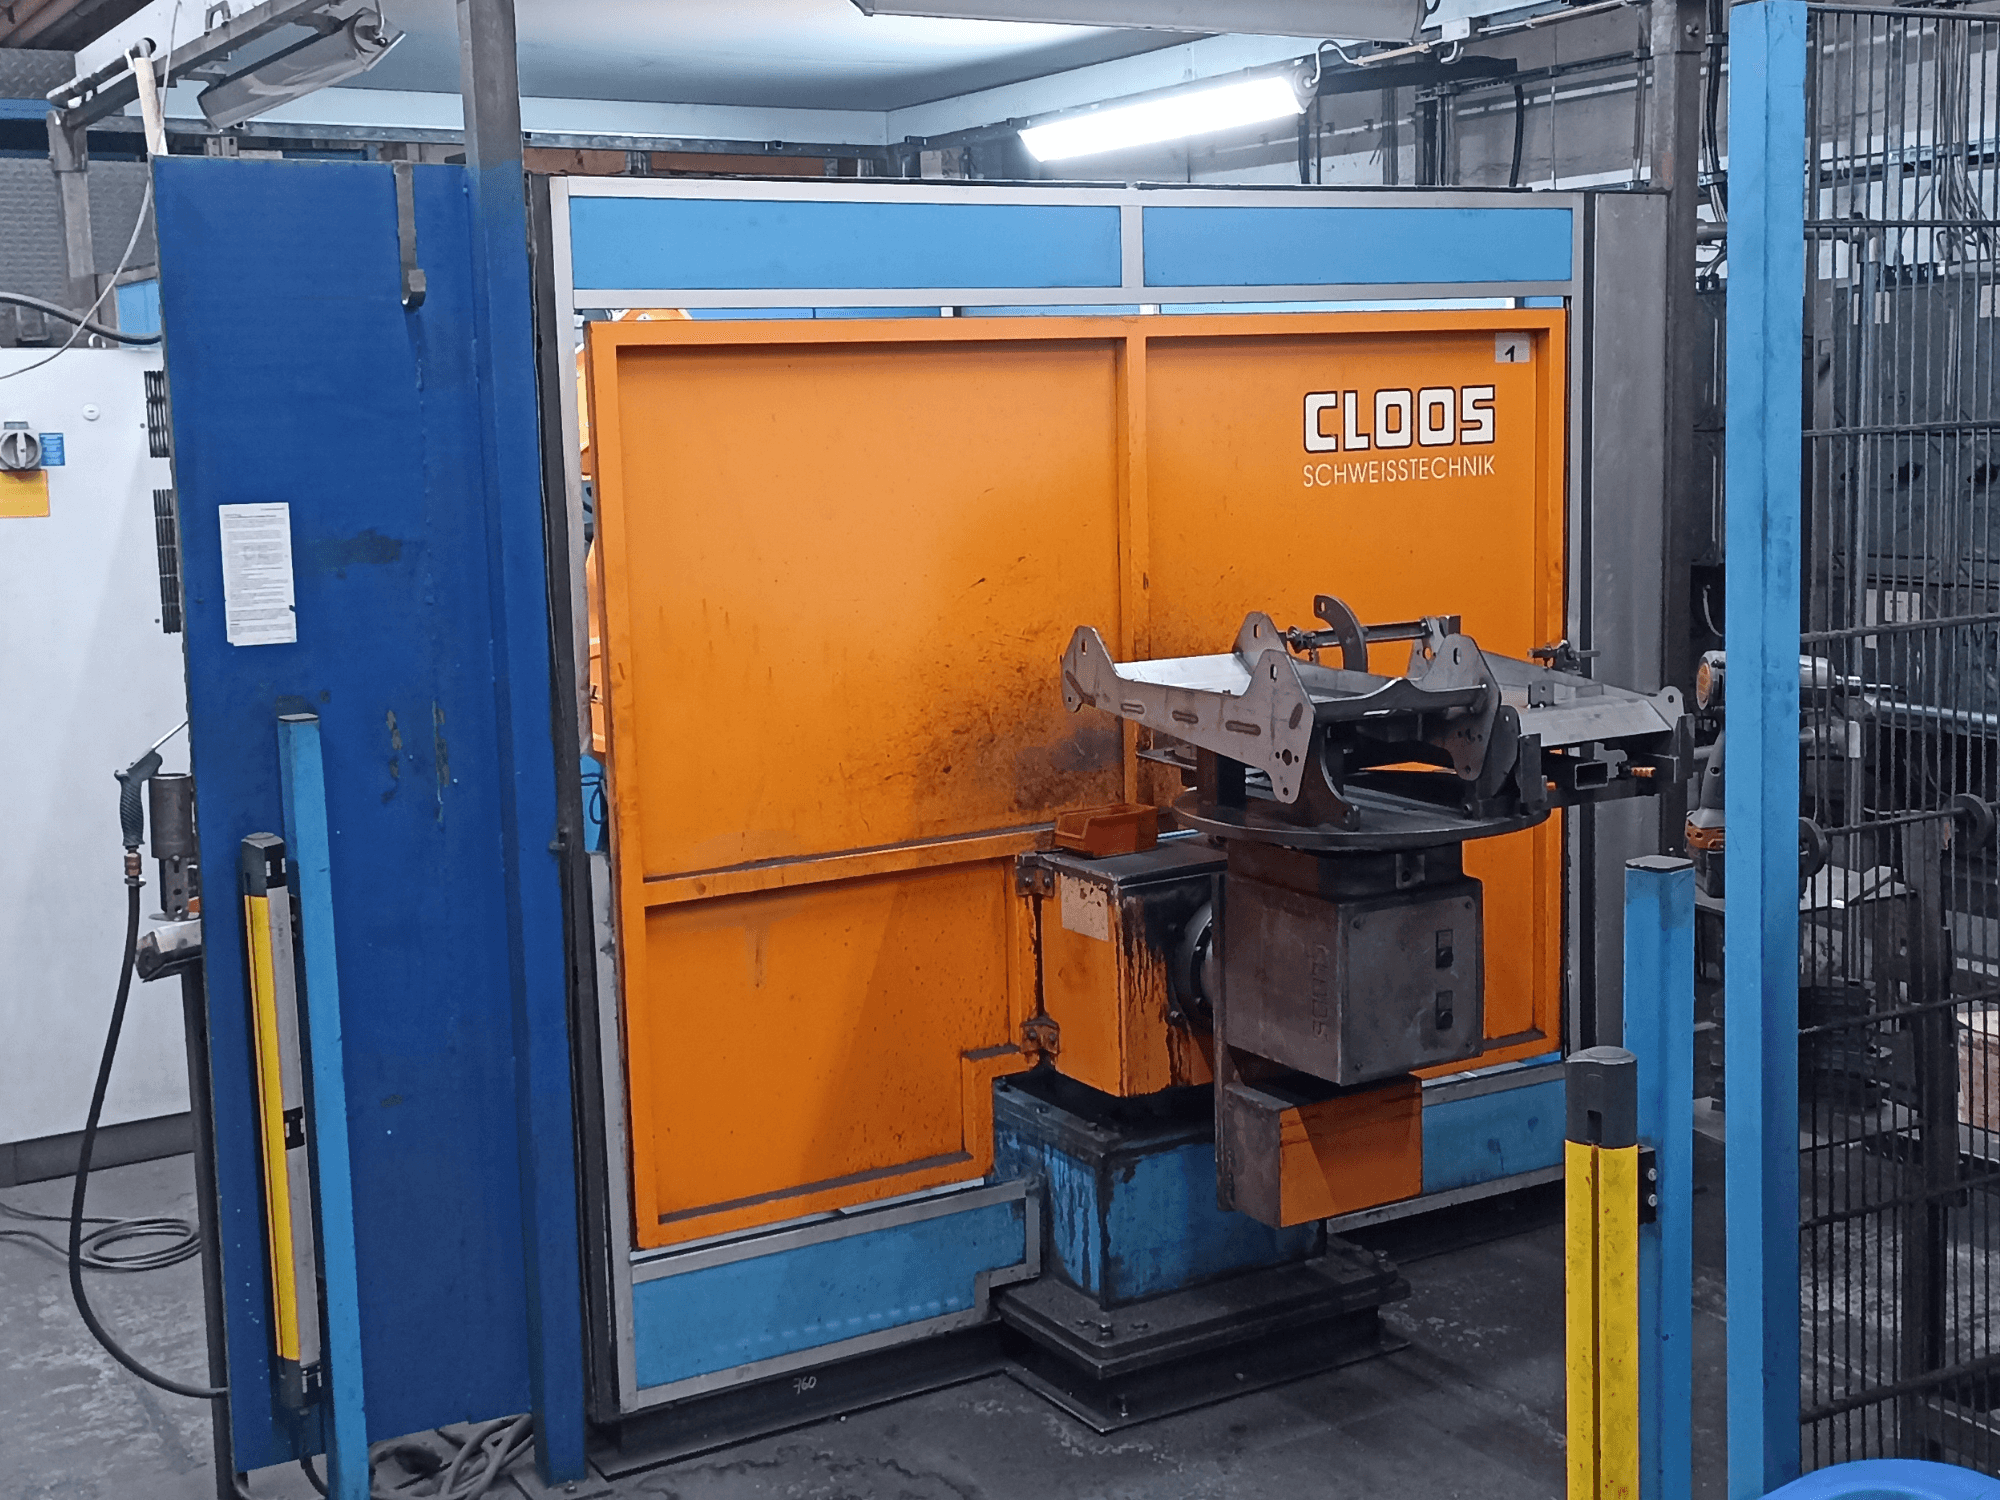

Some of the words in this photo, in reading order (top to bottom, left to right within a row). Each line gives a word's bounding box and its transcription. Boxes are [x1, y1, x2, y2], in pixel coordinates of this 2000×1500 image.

[1504, 345, 1516, 362] 1
[1303, 384, 1496, 453] CLOOS
[1303, 455, 1496, 488] SCHWEISSTECHNIK
[793, 1376, 817, 1395] 760
